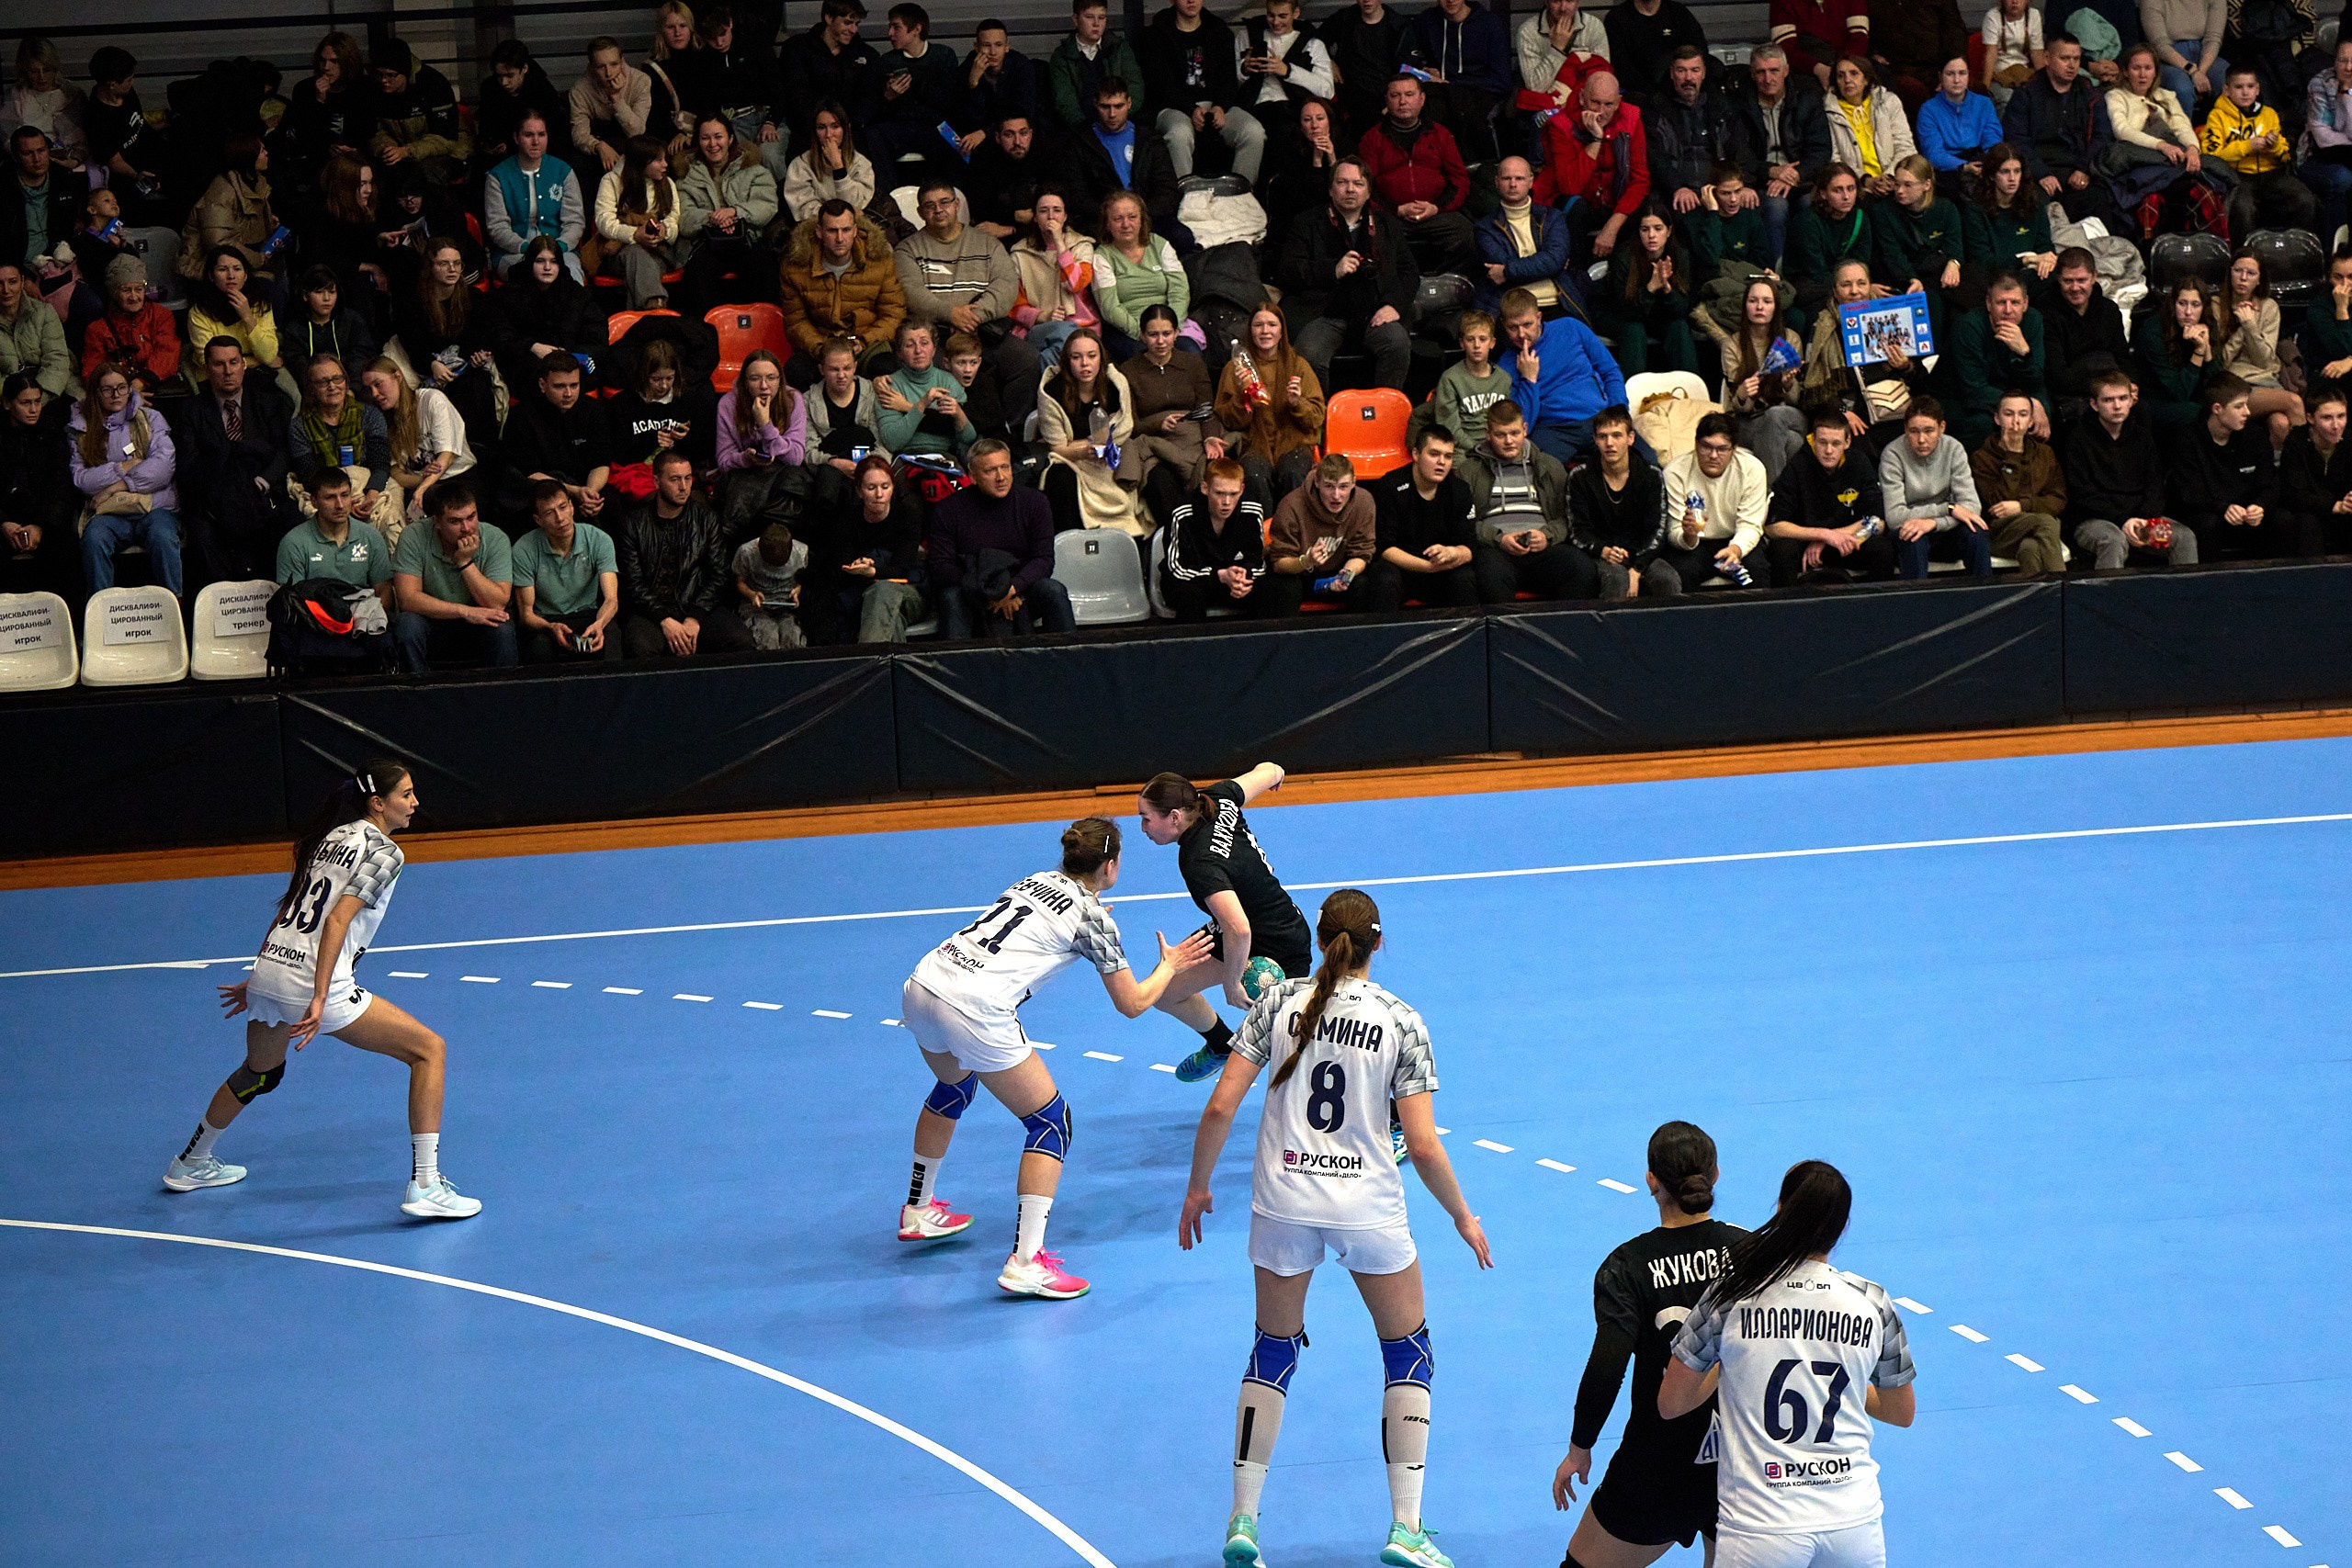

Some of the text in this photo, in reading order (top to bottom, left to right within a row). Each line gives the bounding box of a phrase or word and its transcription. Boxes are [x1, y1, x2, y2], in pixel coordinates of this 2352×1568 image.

[632, 418, 682, 434] ACADEM
[108, 603, 163, 614] ДИСКВАЛИФИ-
[110, 613, 163, 625] ЦИРОВАННЫЙ
[232, 619, 265, 630] тренер
[15, 635, 41, 646] игрок
[125, 628, 152, 638] игрок
[268, 944, 306, 963] РУСКОН
[1288, 1010, 1383, 1053] СМИНА
[1306, 1060, 1346, 1134] 8
[1300, 1153, 1362, 1170] РУСКОН
[1305, 1169, 1339, 1178] КОМПАНИЙ
[1740, 1308, 1873, 1348] ИЛЛАРИОНОВА
[1763, 1359, 1850, 1444] 67
[1785, 1457, 1851, 1478] РУСКОН
[1792, 1478, 1831, 1487] КОМПАНИЙ
